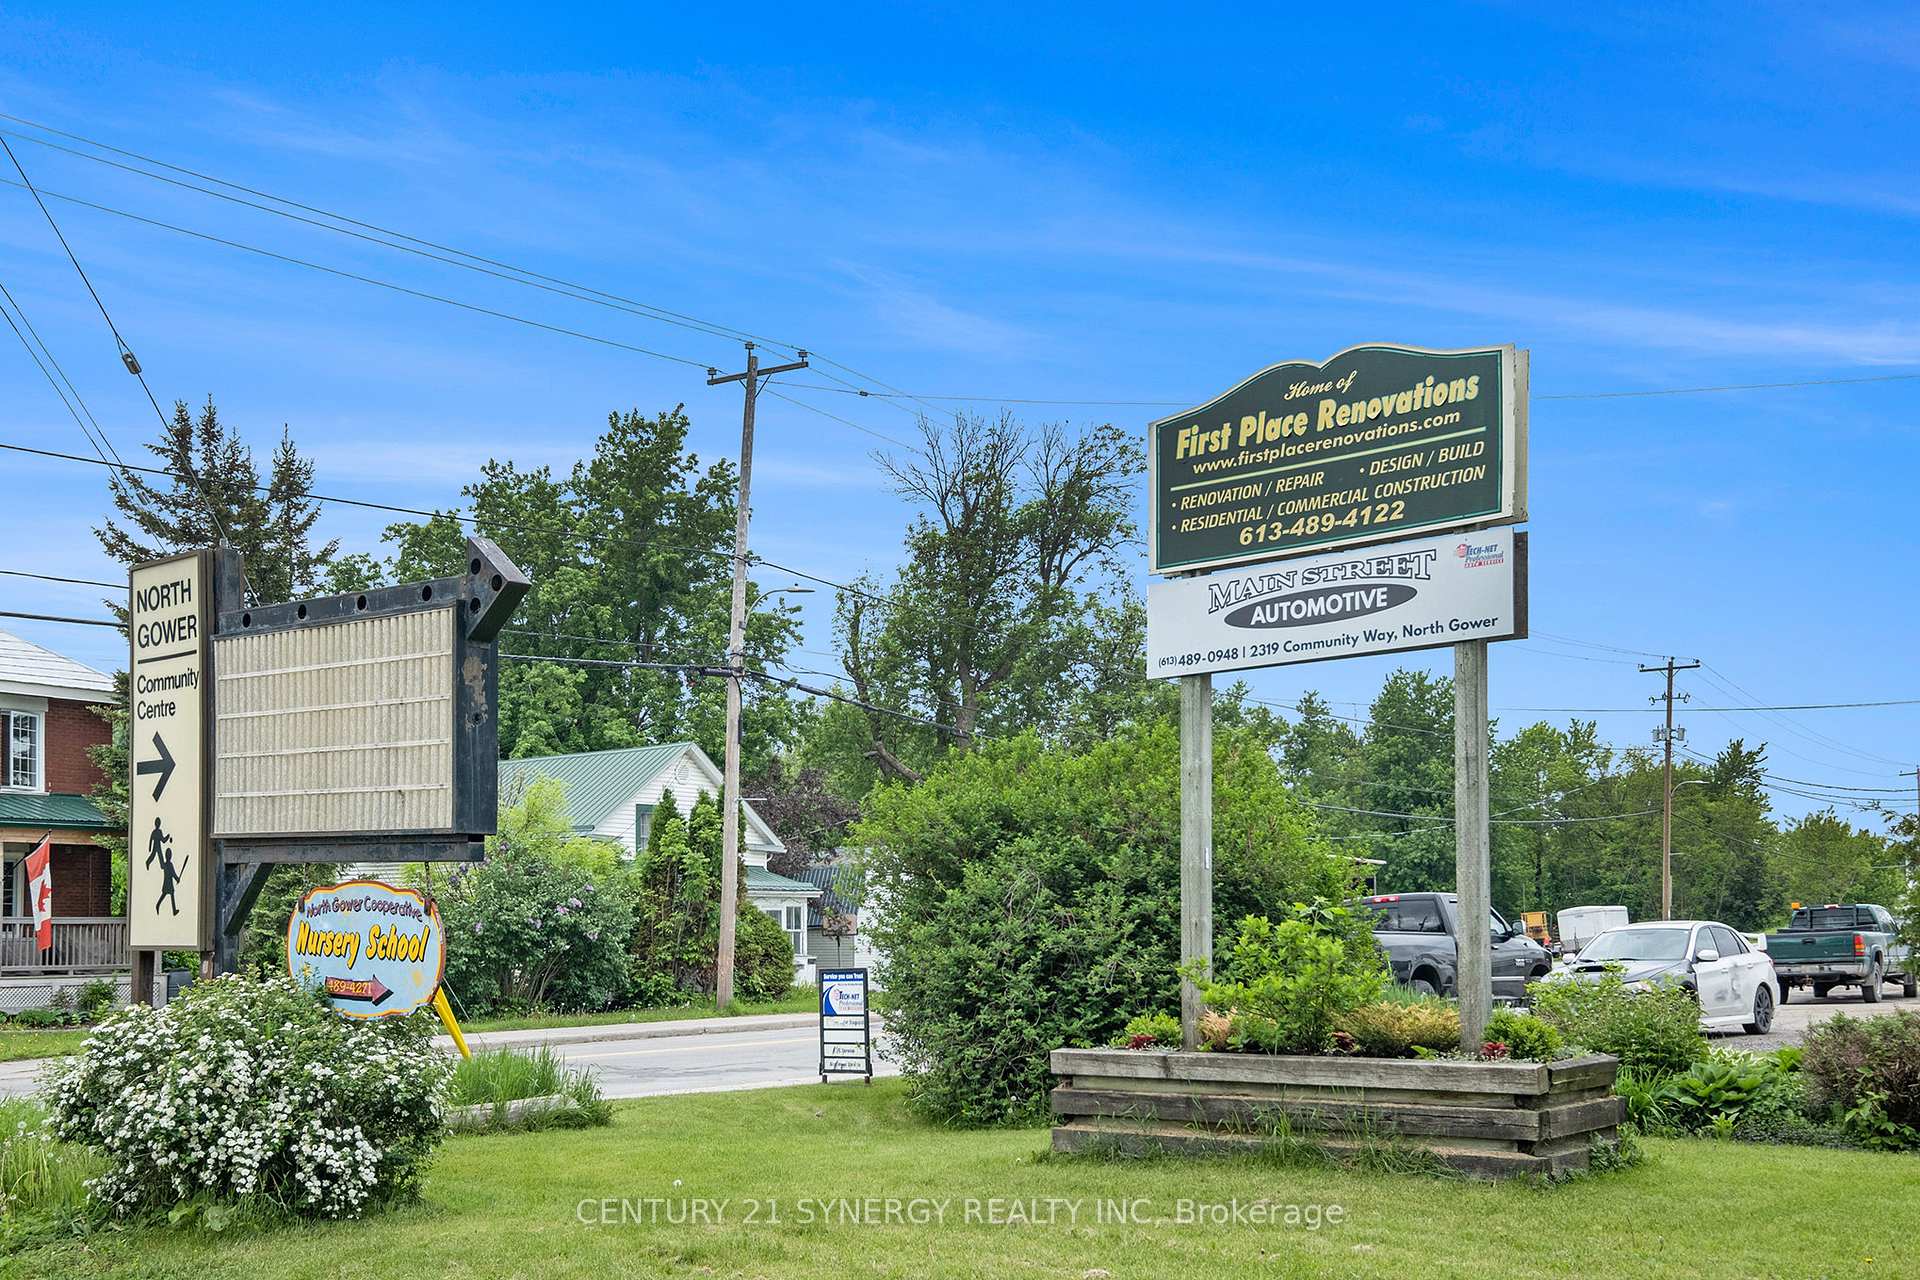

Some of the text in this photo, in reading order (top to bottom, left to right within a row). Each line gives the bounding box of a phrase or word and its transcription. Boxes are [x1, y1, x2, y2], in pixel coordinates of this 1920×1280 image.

[1284, 369, 1358, 401] Home of
[1175, 374, 1481, 460] First Place Renovations
[1192, 408, 1462, 474] www.firstplacerenovations.com
[1369, 452, 1424, 477] DESIGN
[1438, 441, 1485, 464] BUILD
[1180, 482, 1263, 511] RENOVATION
[1276, 471, 1325, 494] REPAIR
[1180, 504, 1264, 534] RESIDENTIAL
[1277, 487, 1370, 517] COMMERCIAL
[1374, 464, 1486, 500] CONSTRUCTION
[1238, 500, 1406, 546] 613-489-4122
[136, 578, 192, 613] NORTH
[1208, 549, 1437, 614] MAIN STREET
[1250, 588, 1388, 626] AUTOMOTIVE
[137, 614, 198, 649] GOWER
[1158, 655, 1178, 668] (613)
[1178, 648, 1239, 668] 489-0948
[1250, 643, 1280, 658] 2319
[1283, 632, 1360, 656] Community
[1363, 627, 1399, 645] Way,
[1402, 620, 1445, 638] North
[1448, 615, 1499, 632] Gower
[137, 668, 200, 694] Community
[137, 700, 176, 720] Centre
[306, 895, 423, 922] North Gower Cooperative
[295, 919, 431, 970] Nursery School
